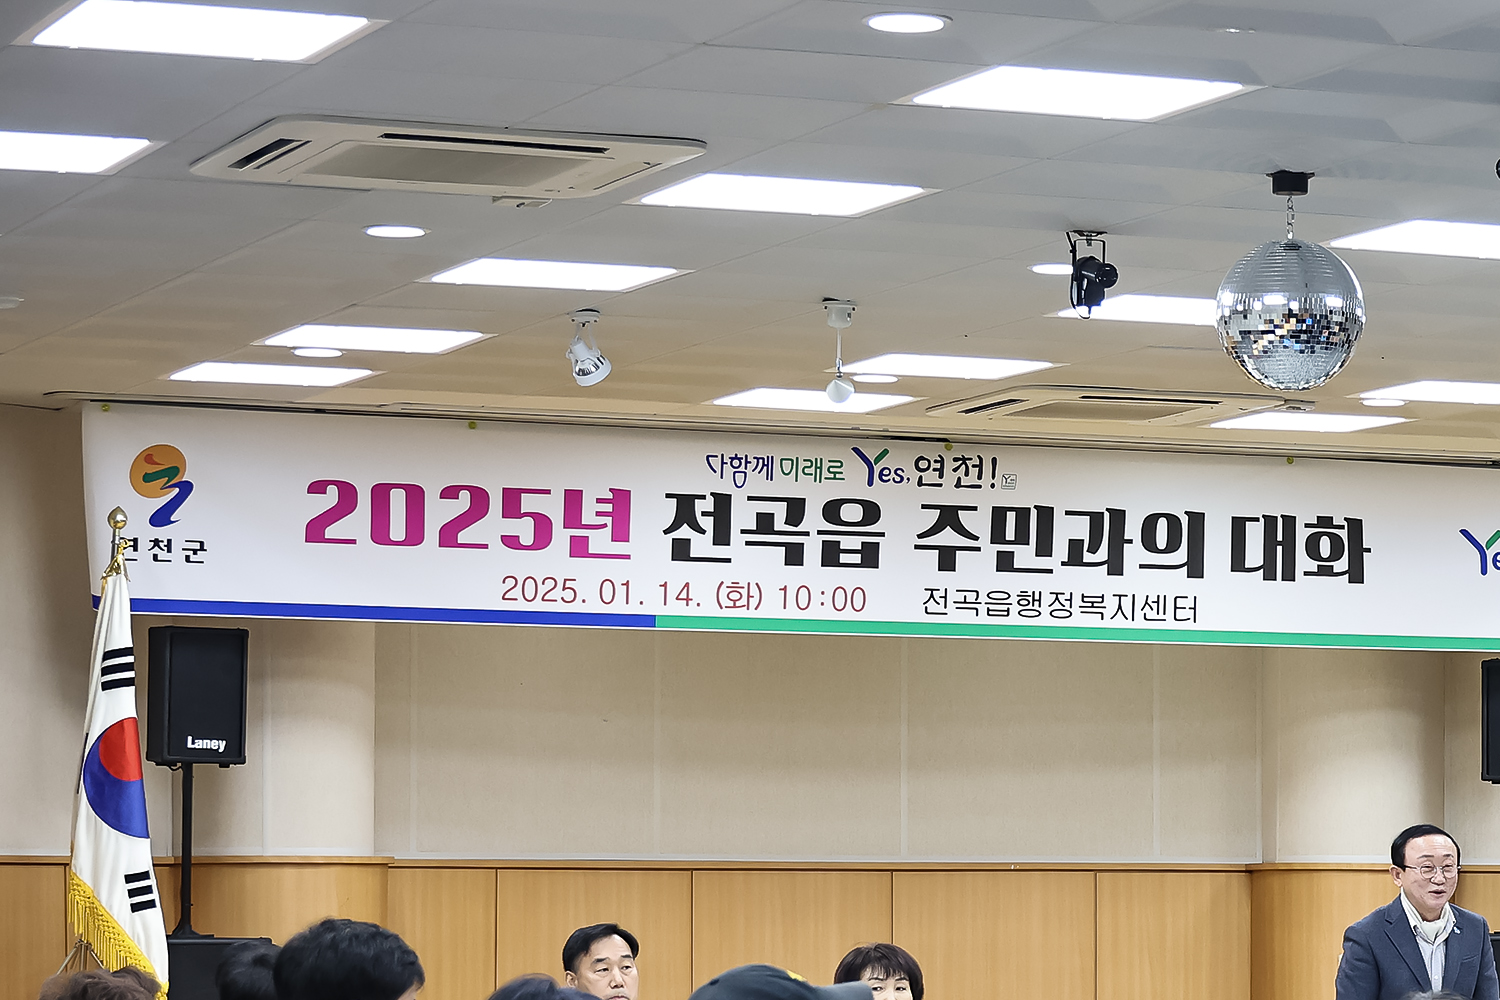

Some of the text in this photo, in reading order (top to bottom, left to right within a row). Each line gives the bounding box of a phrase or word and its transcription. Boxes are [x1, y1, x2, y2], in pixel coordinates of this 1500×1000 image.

[705, 453, 774, 489] 다함께
[779, 455, 846, 483] 미래로
[304, 479, 1372, 585] 2025년 전곡읍 주민과의 대화
[501, 575, 867, 612] 2025. 01. 14. (화) 10:00
[921, 587, 1198, 624] 전곡읍행정복지센터
[186, 735, 227, 753] Laney
